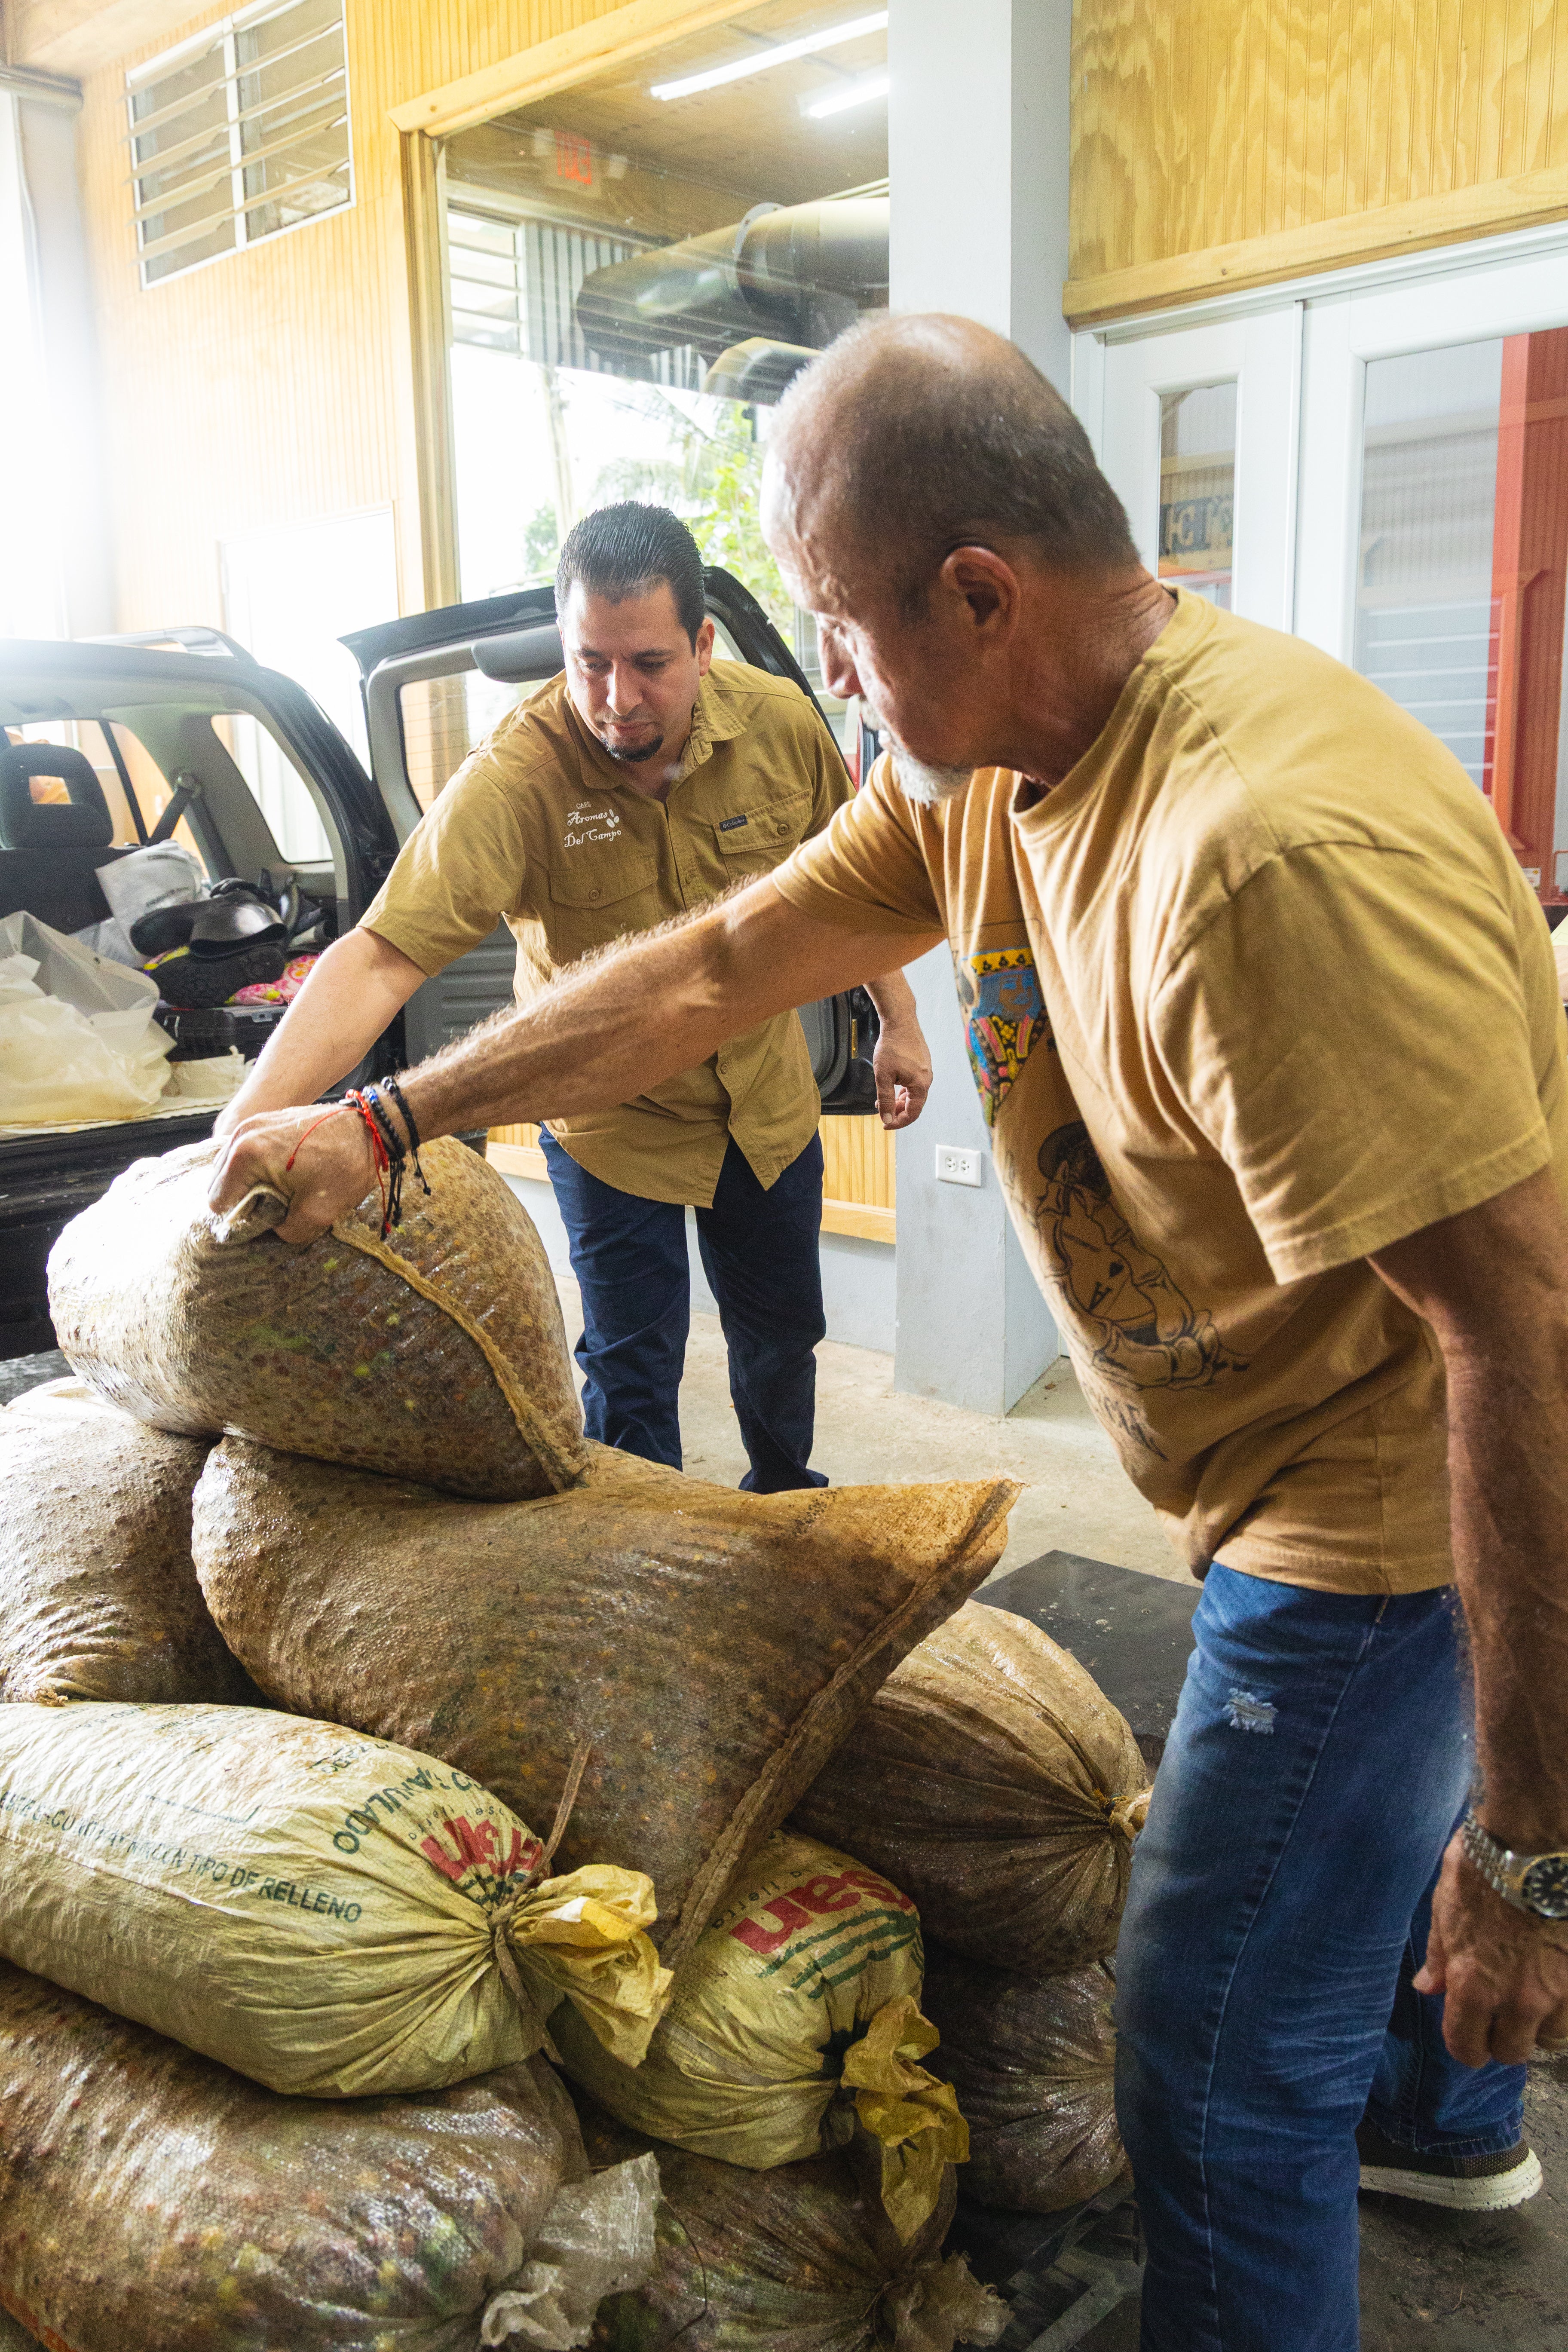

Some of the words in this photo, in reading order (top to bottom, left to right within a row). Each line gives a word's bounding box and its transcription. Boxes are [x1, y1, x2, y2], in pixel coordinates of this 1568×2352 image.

[567, 811, 608, 826] Aromas
[726, 818, 745, 827] Columbia
[564, 832, 585, 847] Del
[585, 829, 622, 841] Campo
[188, 1854, 228, 1882] TIPO
[230, 1867, 259, 1891] DE
[258, 1877, 362, 1923] RELLENO
[711, 1881, 780, 1929] tierra
